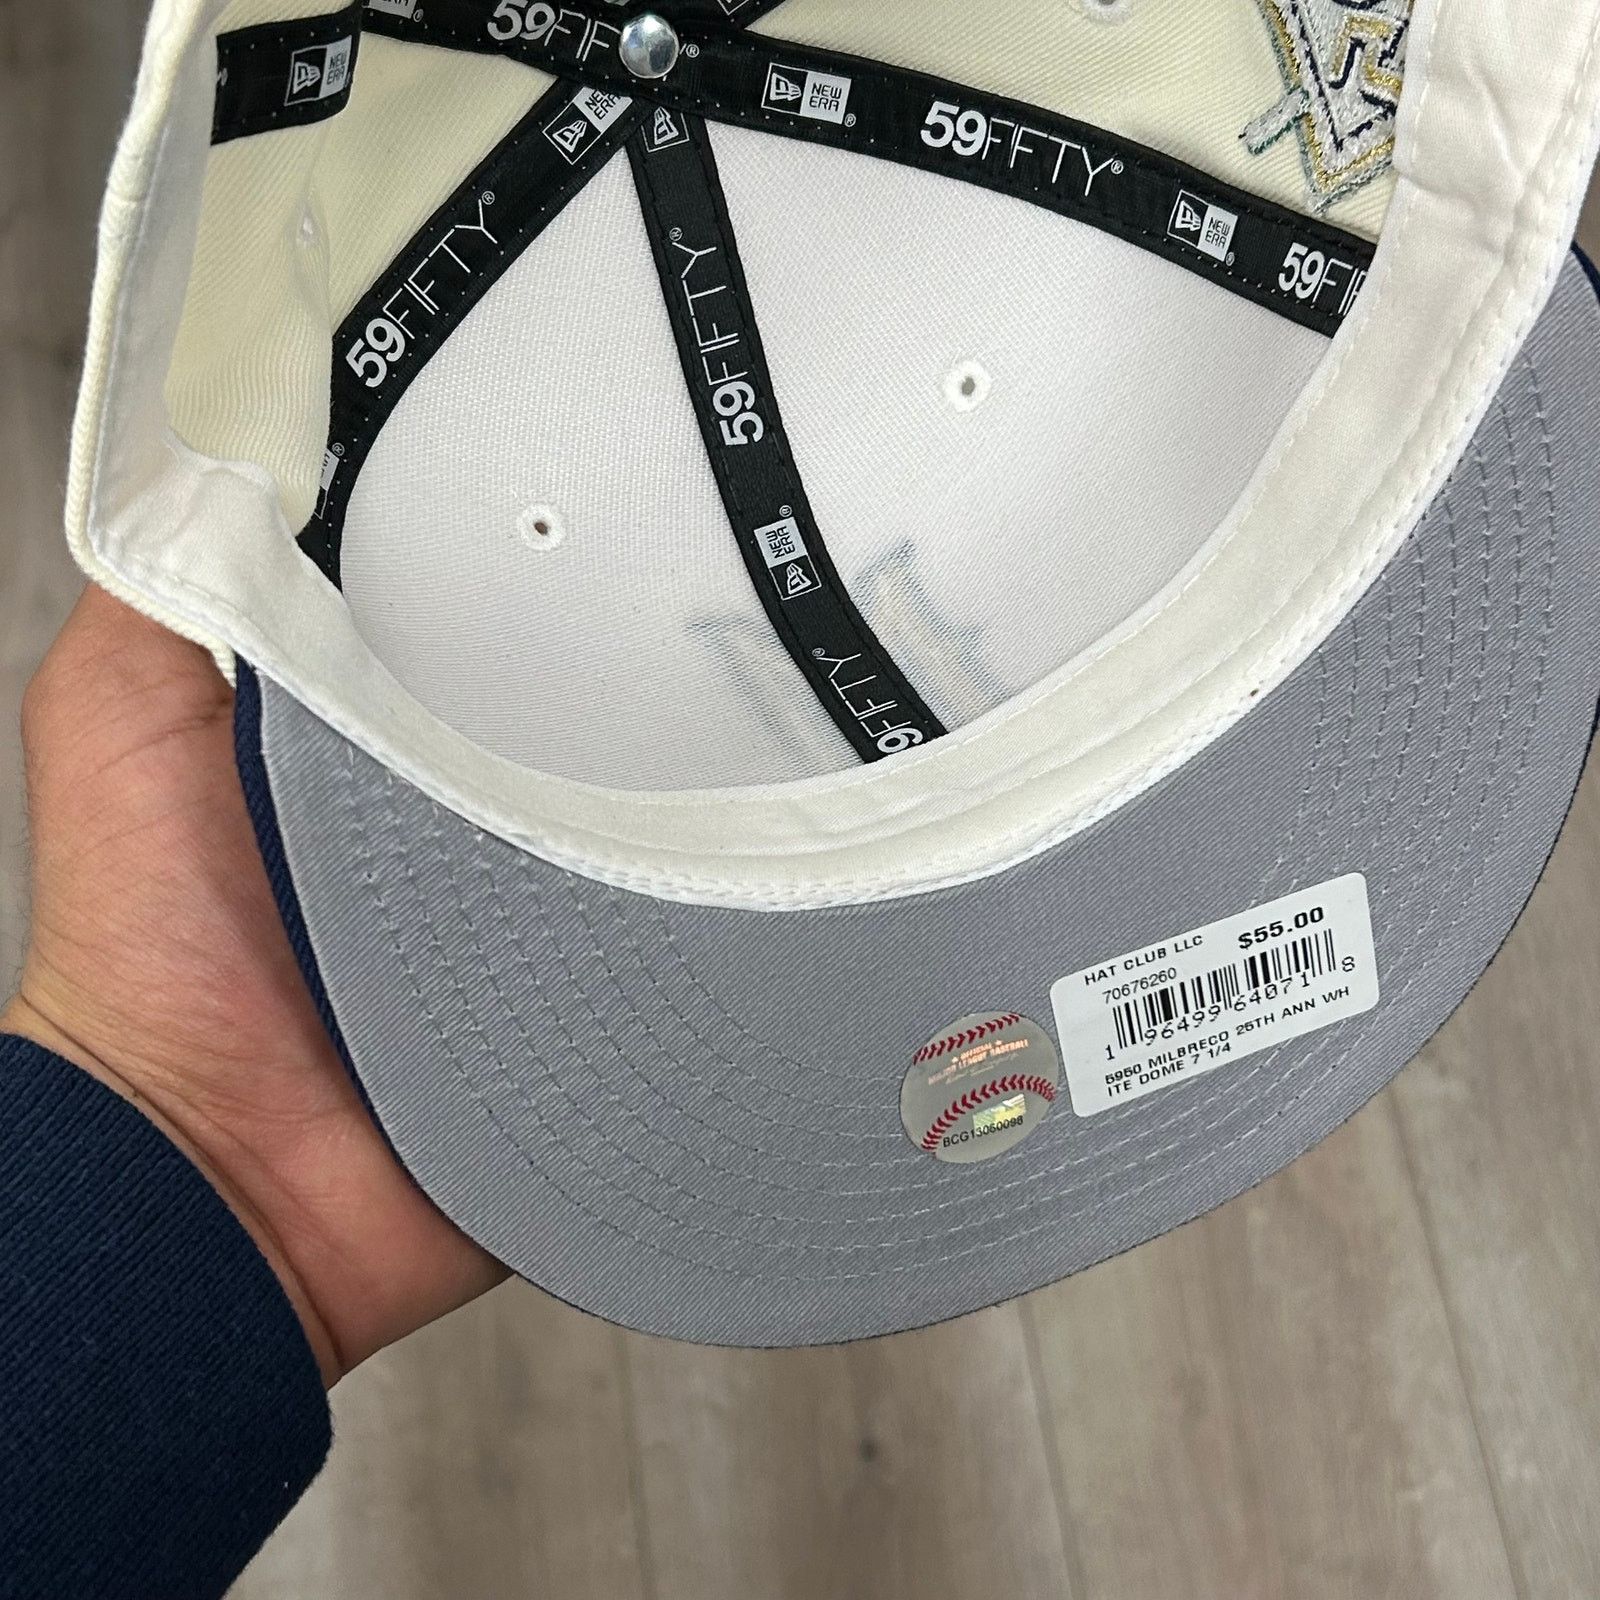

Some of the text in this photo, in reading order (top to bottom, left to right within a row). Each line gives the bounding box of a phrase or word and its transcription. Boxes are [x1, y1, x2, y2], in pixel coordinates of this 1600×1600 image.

[585, 90, 607, 111] NE
[809, 96, 839, 112] ERA
[811, 82, 842, 100] NEW
[1204, 230, 1227, 249] ERA
[1208, 216, 1231, 237] NEW
[1278, 242, 1367, 316] 59FIF
[765, 529, 786, 559] NEW
[776, 525, 796, 555] ERA
[1237, 906, 1324, 950] $55.00
[1084, 935, 1203, 986] HAT CLUB LLC
[1102, 967, 1177, 1005] 70676260
[1105, 1044, 1115, 1061] 1
[1341, 956, 1356, 973] 8
[1104, 986, 1349, 1085] 5950 MILBRECO 25TH ANN WH
[1107, 1042, 1231, 1097] ITE DOME 7 1/4
